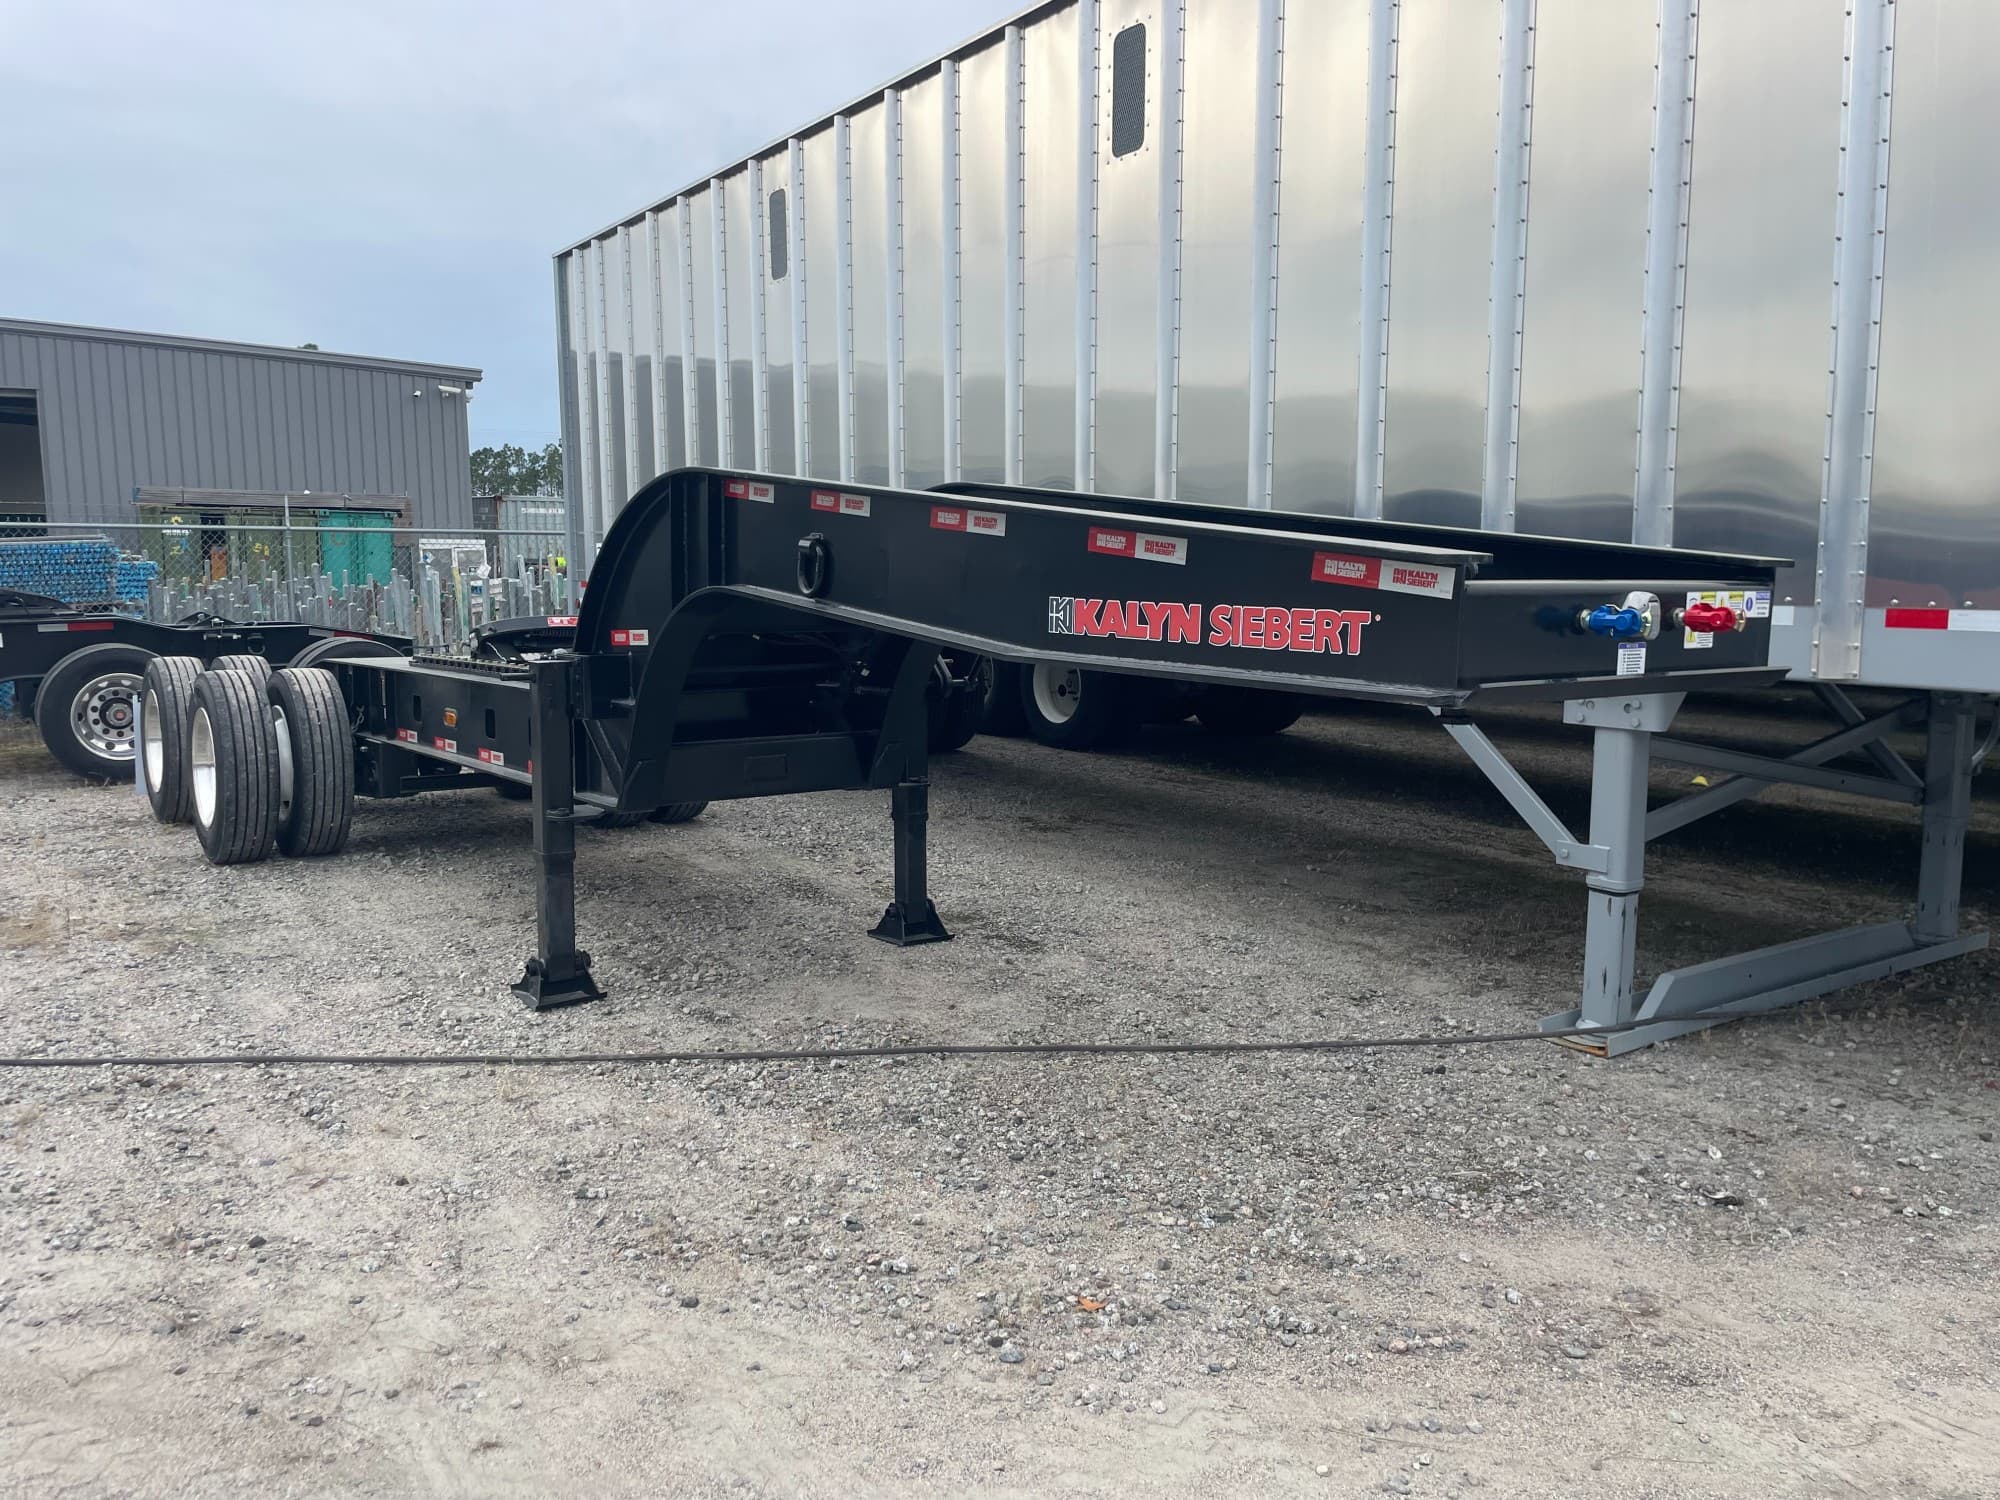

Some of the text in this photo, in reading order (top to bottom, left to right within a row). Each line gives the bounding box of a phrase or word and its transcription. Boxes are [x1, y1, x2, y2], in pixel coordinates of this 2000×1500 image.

[1338, 560, 1366, 571] KALYN
[1337, 568, 1366, 579] SIEBERT
[1407, 569, 1439, 581] KALYN
[1406, 578, 1439, 589] SIEBERT
[1074, 598, 1373, 655] KALYN SIEBERT
